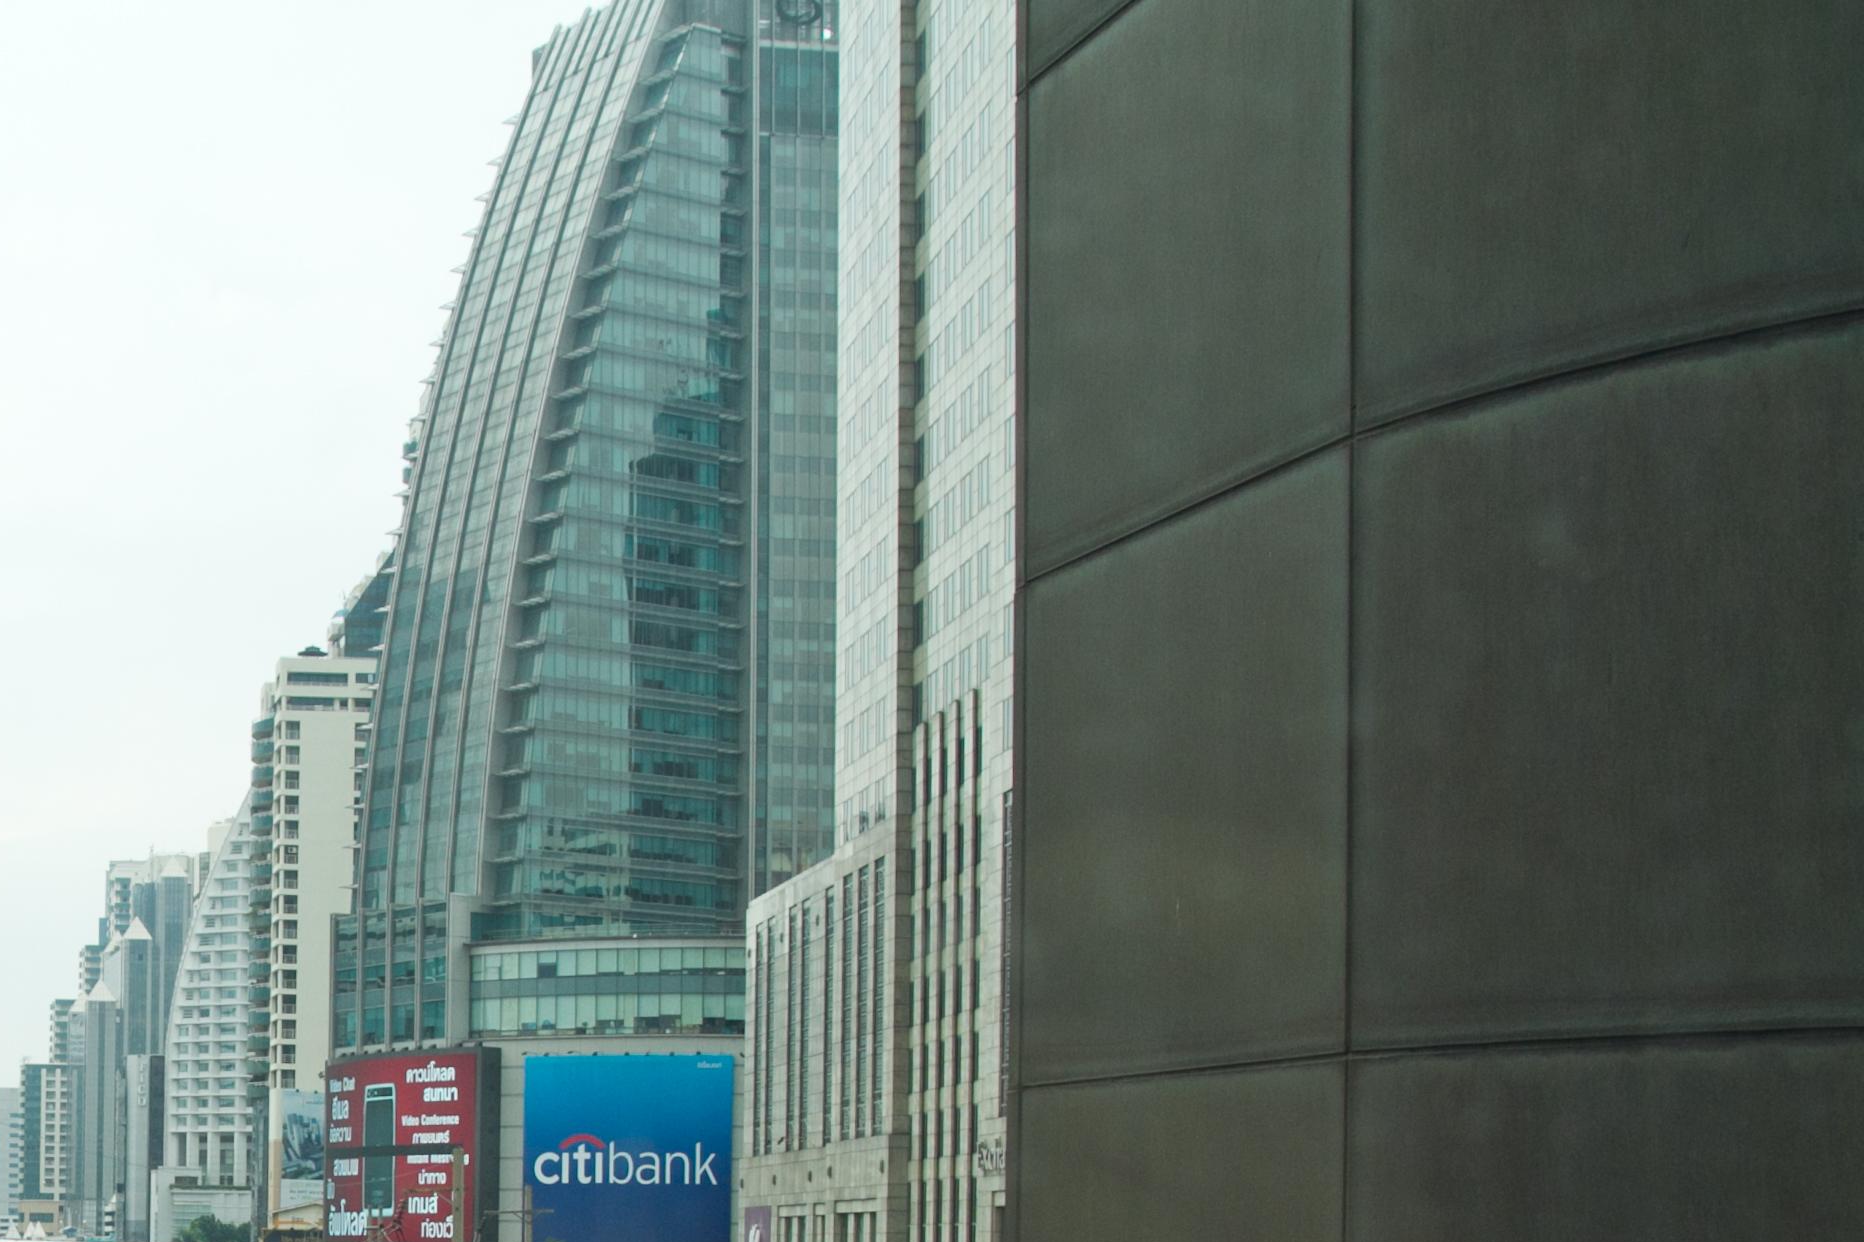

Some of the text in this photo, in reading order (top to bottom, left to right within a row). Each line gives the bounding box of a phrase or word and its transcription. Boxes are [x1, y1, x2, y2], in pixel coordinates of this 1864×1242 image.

[405, 1060, 456, 1083] ดาวน์โหลด
[423, 1086, 459, 1102] สนทนา
[534, 1140, 718, 1185] citibank
[420, 1215, 454, 1239] ท่องเว็
